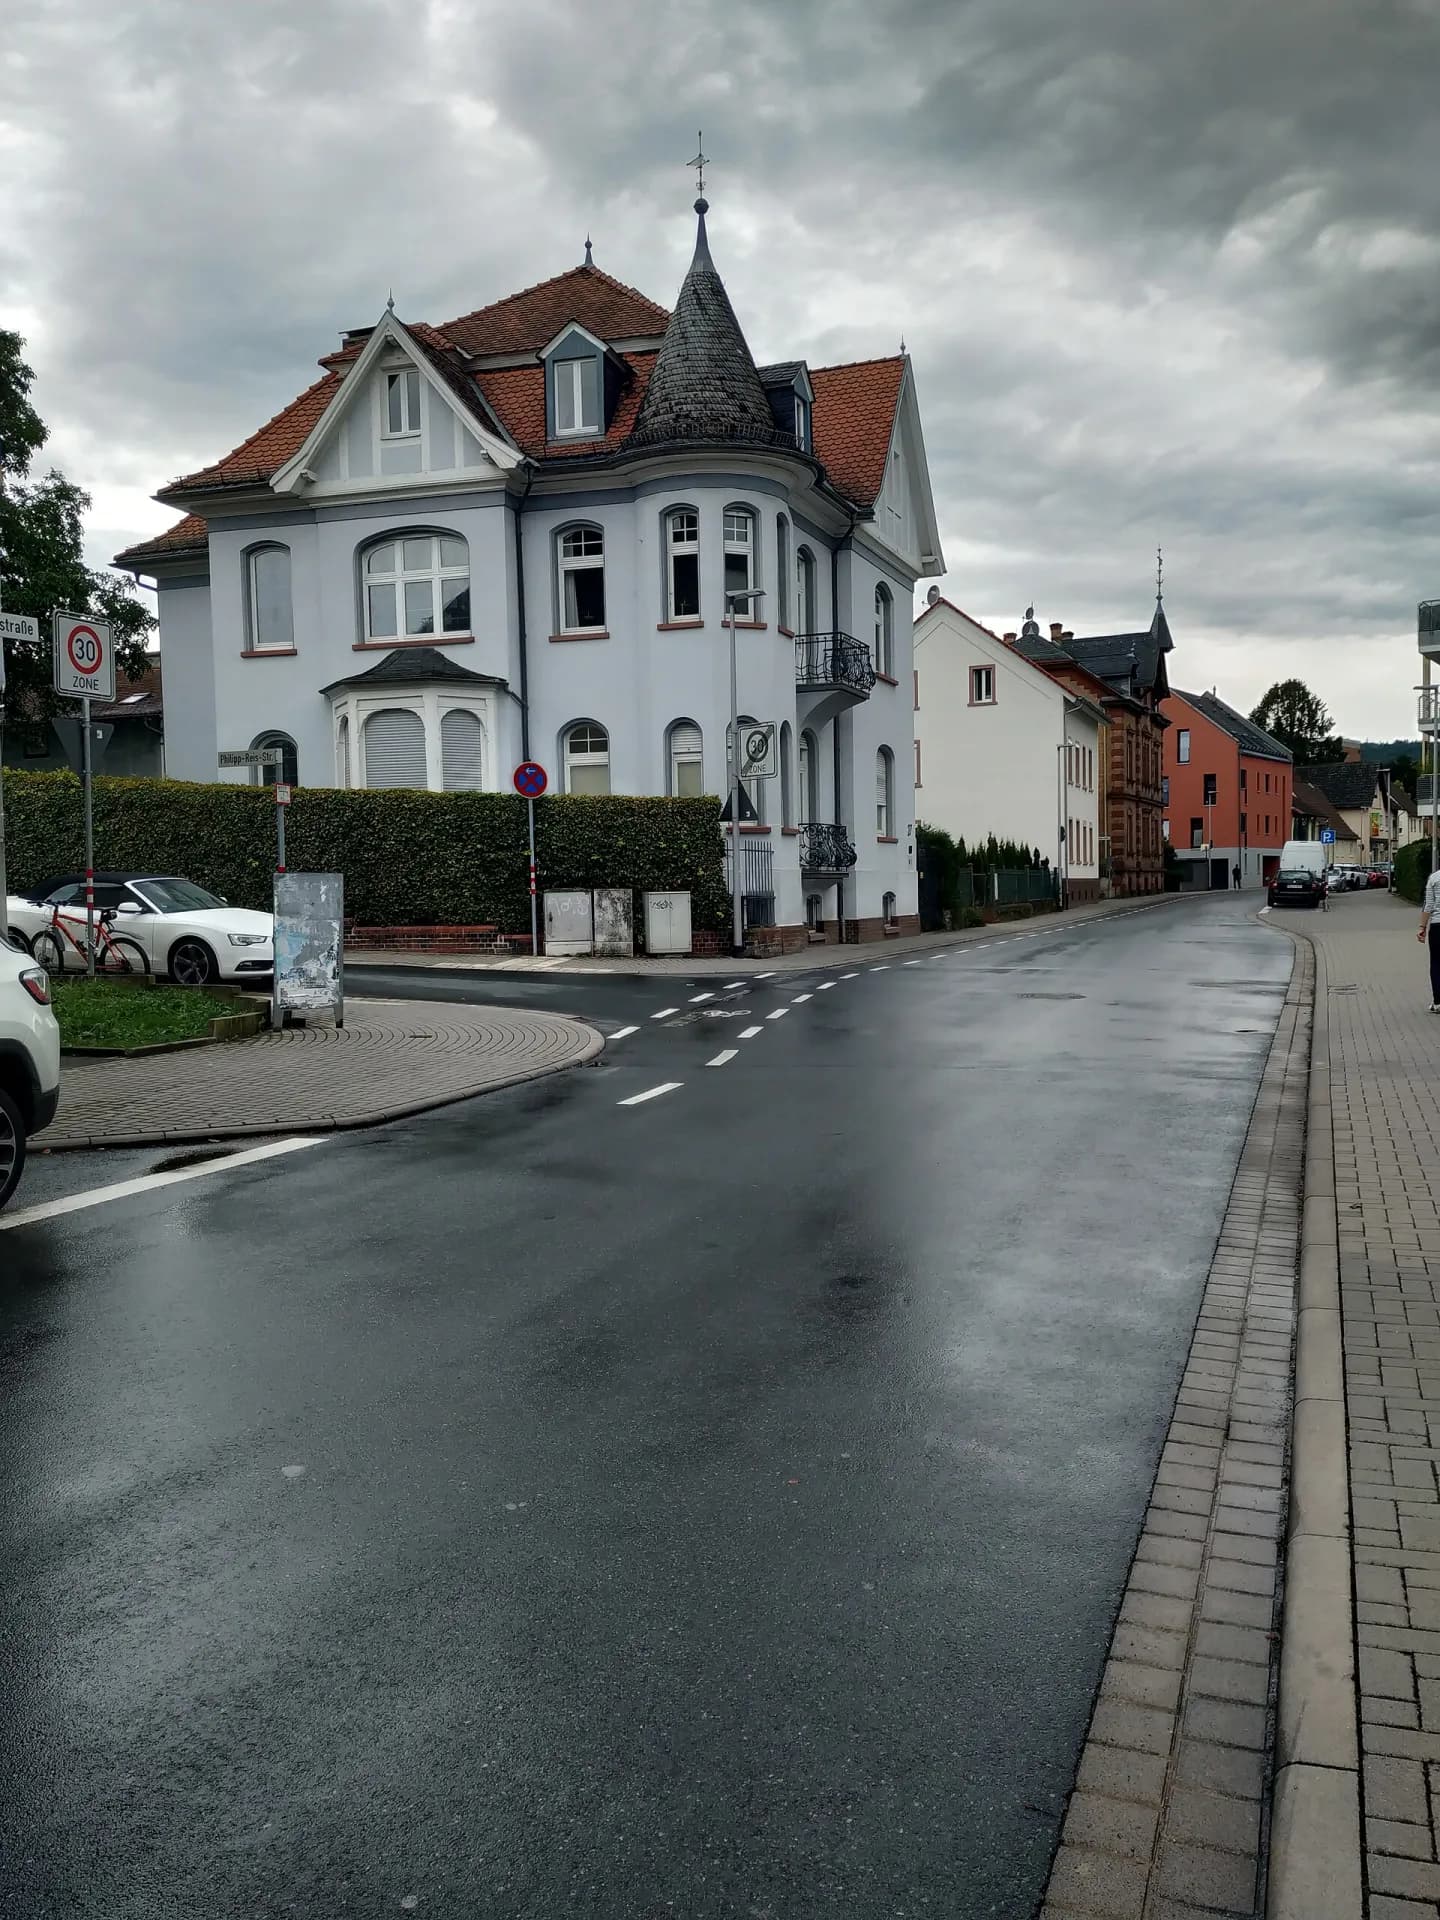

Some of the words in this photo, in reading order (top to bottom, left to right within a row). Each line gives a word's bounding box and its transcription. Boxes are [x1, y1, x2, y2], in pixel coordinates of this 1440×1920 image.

[0, 619, 34, 636] straße
[75, 638, 96, 662] 30
[72, 675, 99, 691] ZONE
[751, 738, 764, 754] 30
[220, 751, 274, 766] Philipp-Reis-Str.
[750, 764, 767, 774] ZONE
[1323, 832, 1332, 843] P
